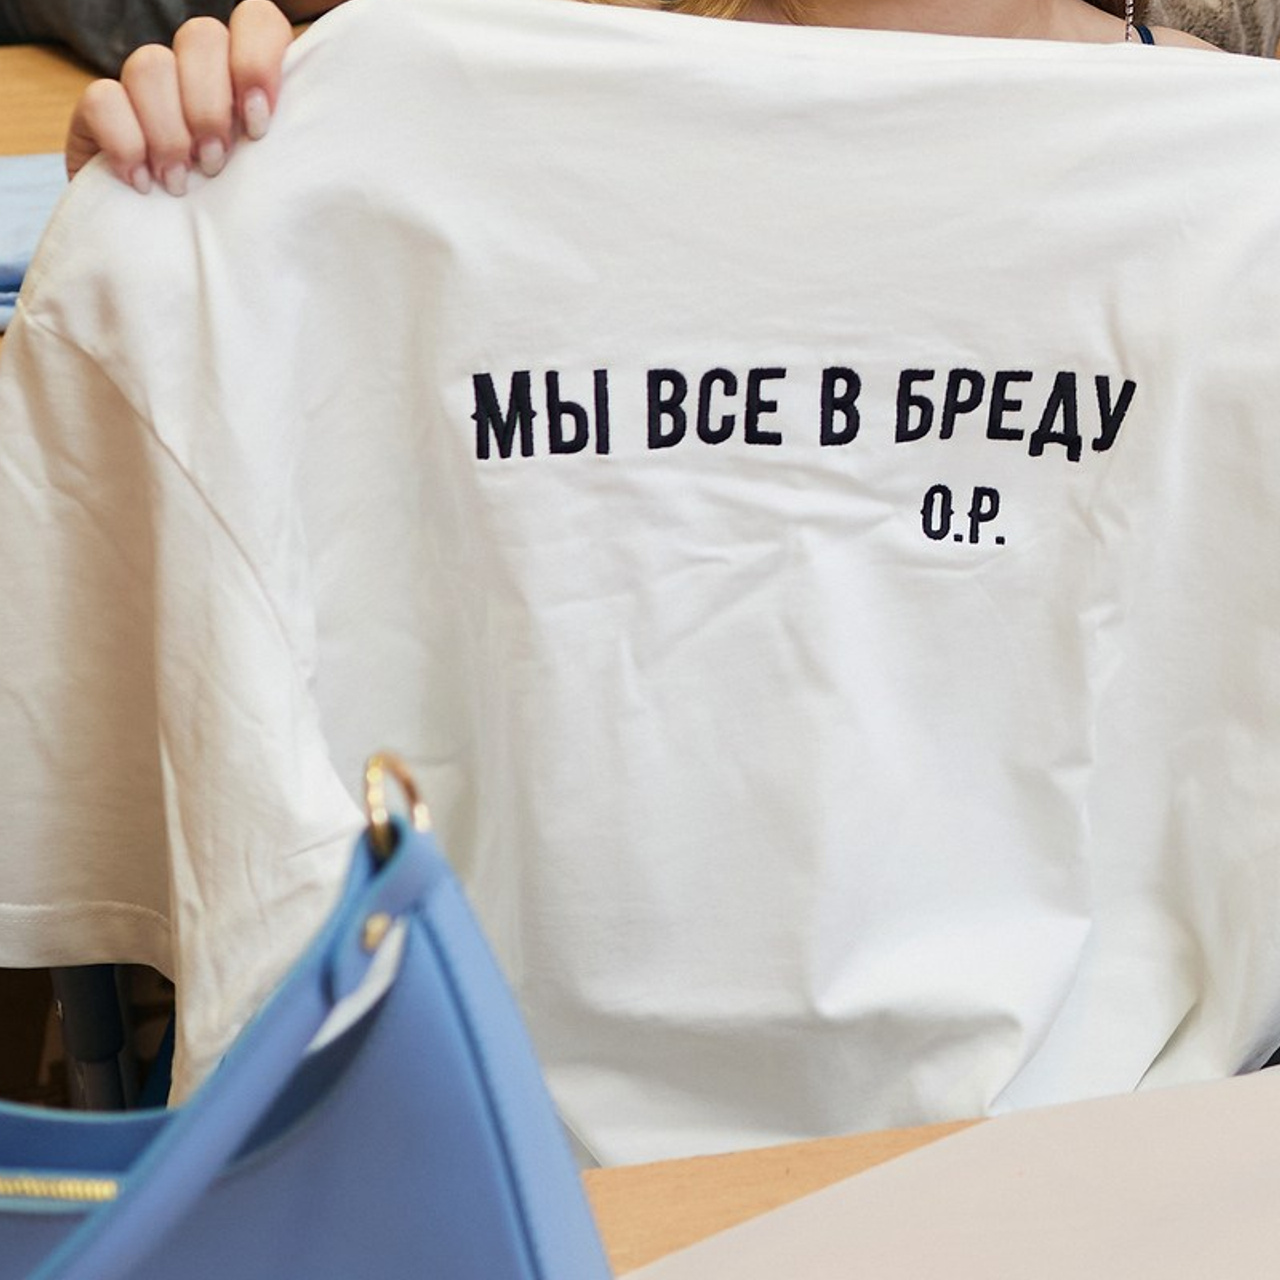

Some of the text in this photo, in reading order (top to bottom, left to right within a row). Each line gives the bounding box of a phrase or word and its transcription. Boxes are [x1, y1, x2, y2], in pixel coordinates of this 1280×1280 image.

[470, 366, 1137, 463] МЫ ВСЕ В БРЕДУ
[920, 483, 1006, 545] О.Р.
